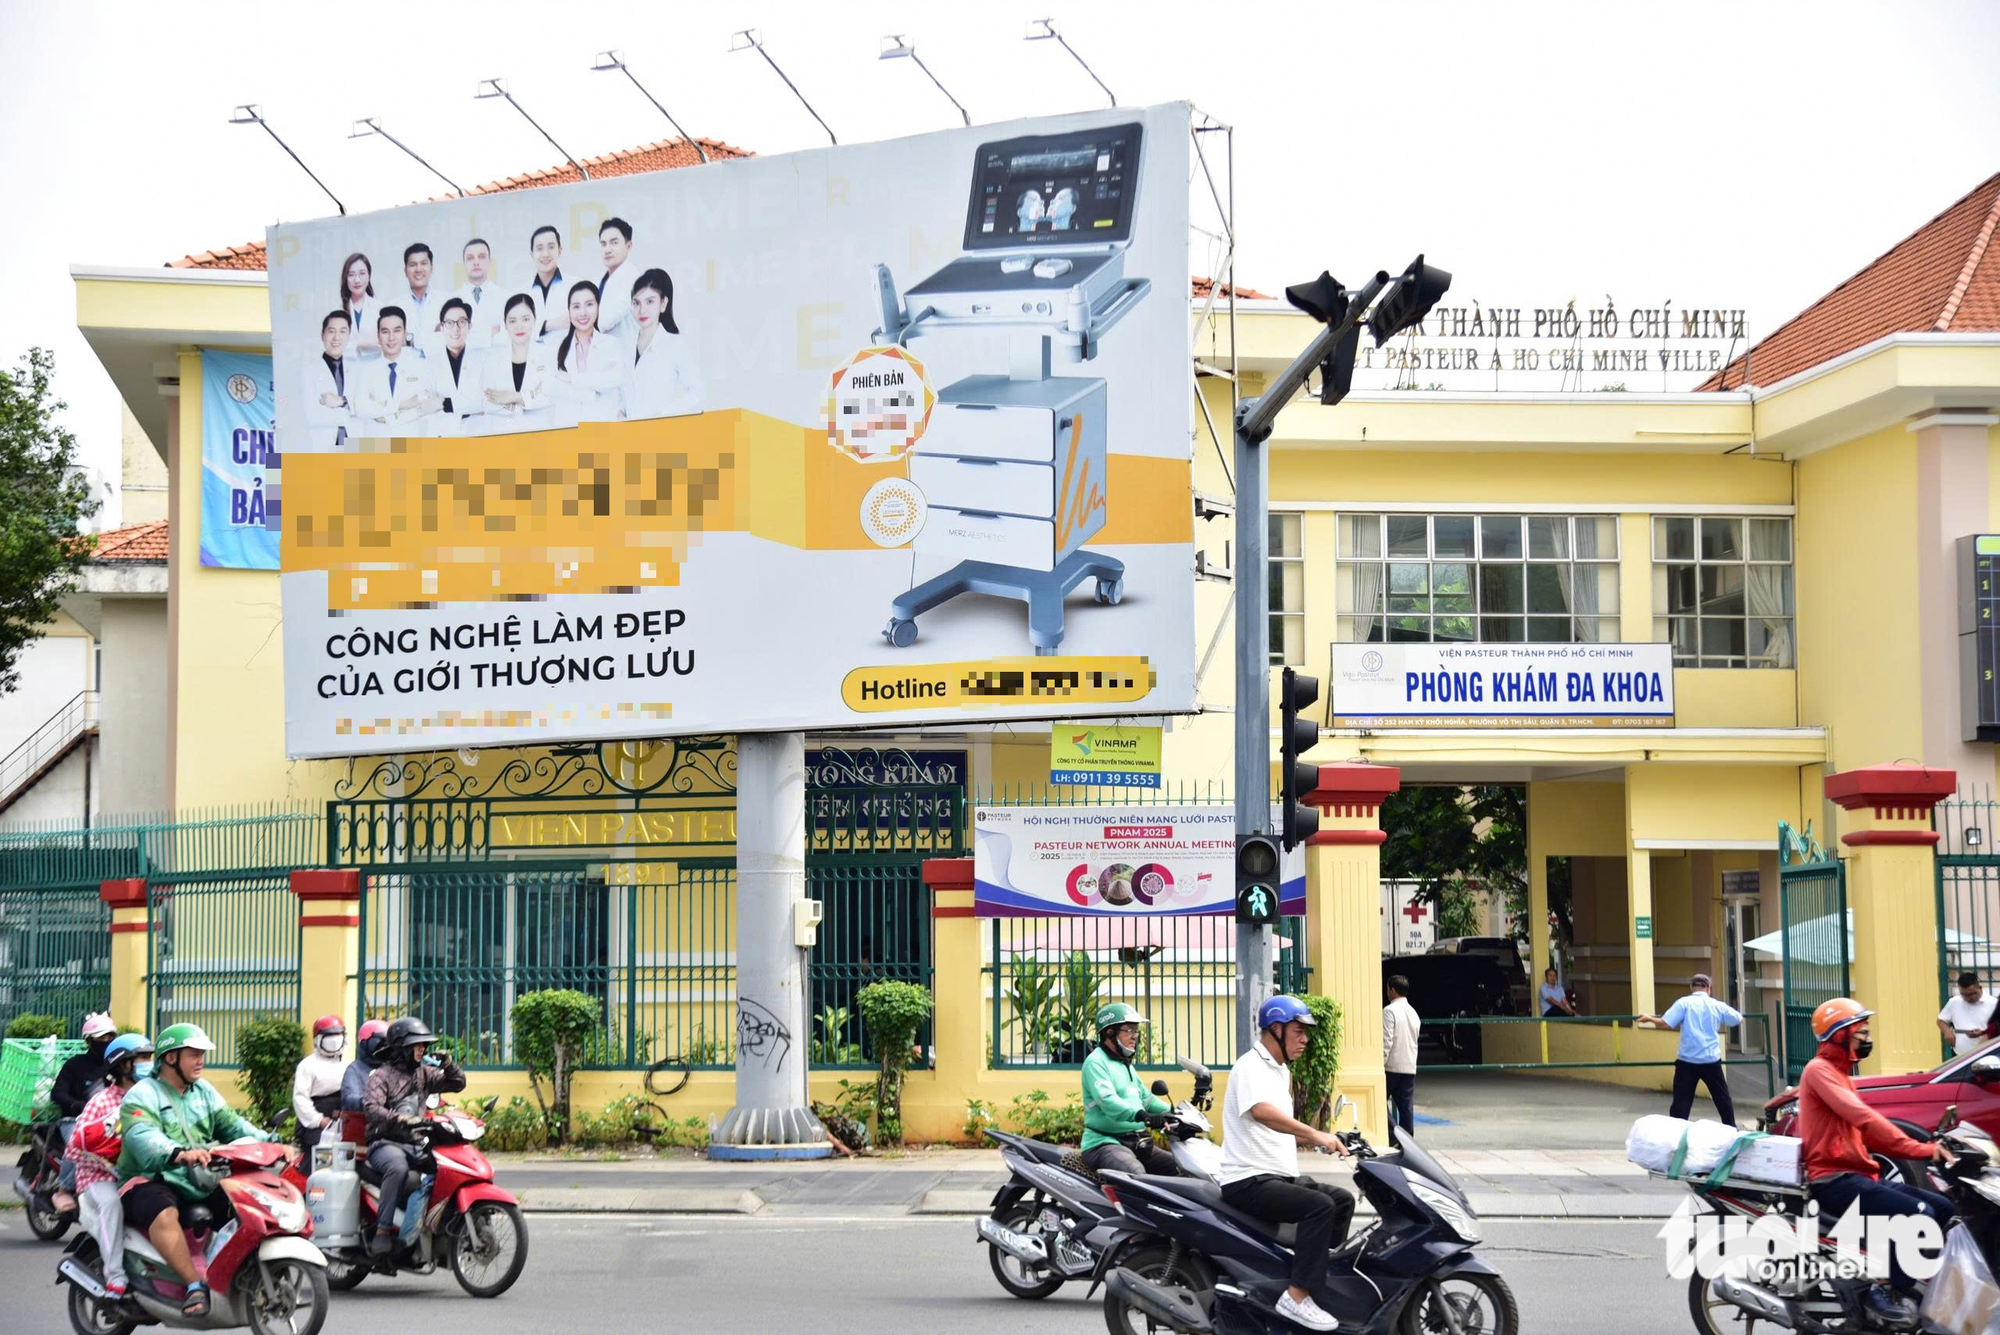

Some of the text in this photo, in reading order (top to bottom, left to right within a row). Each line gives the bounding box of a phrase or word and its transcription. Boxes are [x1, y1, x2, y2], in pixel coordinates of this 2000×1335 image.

[1681, 309, 1746, 338] MINH
[1386, 347, 1479, 370] PASTEUR
[1513, 348, 1539, 370] HO
[1549, 349, 1583, 371] CHI
[1592, 350, 1648, 371] MINH
[1658, 350, 1722, 371] VILLE
[853, 369, 904, 389] PHIÊN BẢN
[1982, 580, 1989, 590] 1
[1982, 608, 1990, 618] 2
[326, 609, 686, 659] CÔNG NGHỆ LÀM ĐẸP
[1439, 649, 1462, 659] VIỆN
[1465, 650, 1508, 658] PASTEUR
[1512, 649, 1545, 658] THÀNH
[1548, 647, 1568, 658] PHỐ
[1608, 650, 1633, 658] MINH
[317, 646, 695, 698] CỦA GIỚI THƯỢNG LƯU
[1984, 671, 1992, 680] 3
[861, 679, 946, 700] Hotline
[1406, 664, 1664, 702] PHÒNG KHÁM ĐA KHOA
[1398, 718, 1414, 726] NAM
[1095, 739, 1137, 748] VINAMA
[805, 760, 957, 784] HÒNG KHÁM
[1056, 772, 1154, 785] LH: 0911 39 5555
[1024, 816, 1042, 827] HỘI
[1045, 816, 1070, 827] NGHỊ
[1074, 814, 1116, 825] THƯỜNG
[1120, 814, 1143, 824] NIÊN
[1147, 815, 1177, 826] MẠNG
[1181, 814, 1204, 824] LƯỚI
[1110, 828, 1167, 836] PNAM 2025
[1034, 842, 1082, 850] PASTEUR
[1086, 841, 1140, 849] NETWORK
[1144, 841, 1188, 849] ANNUAL
[601, 864, 666, 885] 1891
